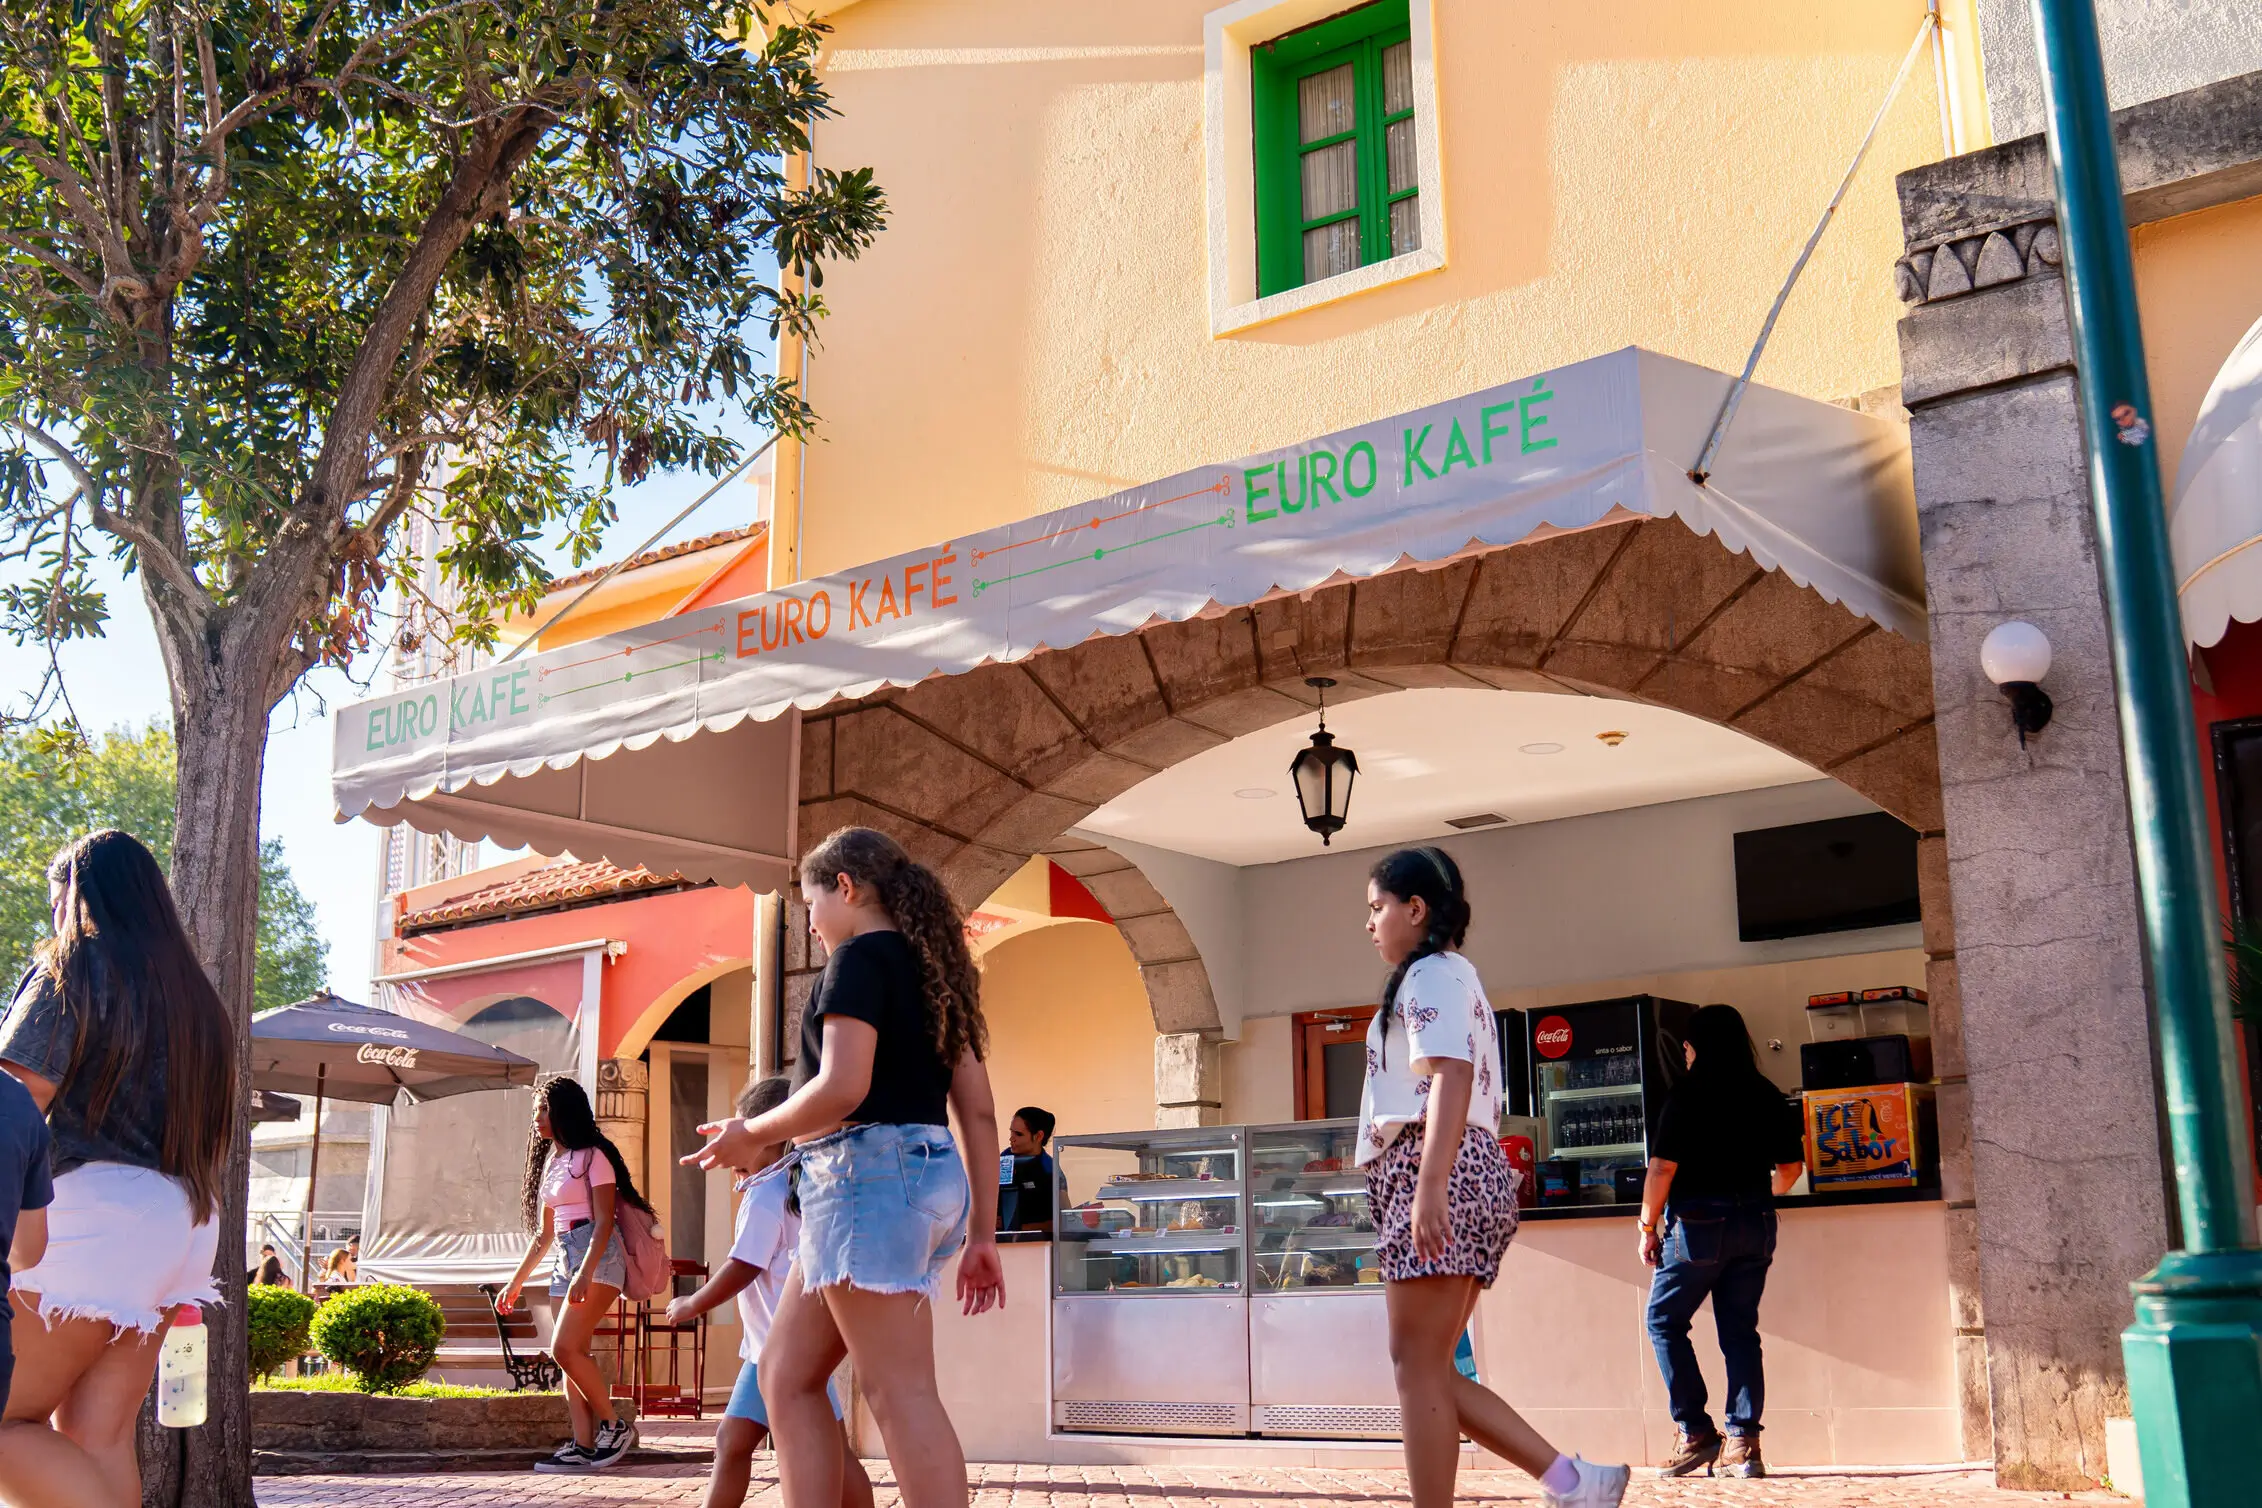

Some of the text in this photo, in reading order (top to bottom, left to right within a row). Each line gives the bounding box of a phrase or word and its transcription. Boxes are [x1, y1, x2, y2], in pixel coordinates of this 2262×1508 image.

[1243, 377, 1558, 524] EURO KAFÉ
[736, 543, 958, 659] EURO KAFÉ
[366, 660, 531, 752] EURO KAFÉ
[328, 1023, 409, 1039] Coca-Cola
[1537, 1029, 1570, 1044] Coca-Cola
[357, 1043, 419, 1068] Coca-Cola
[1817, 1129, 1897, 1168] Sabor
